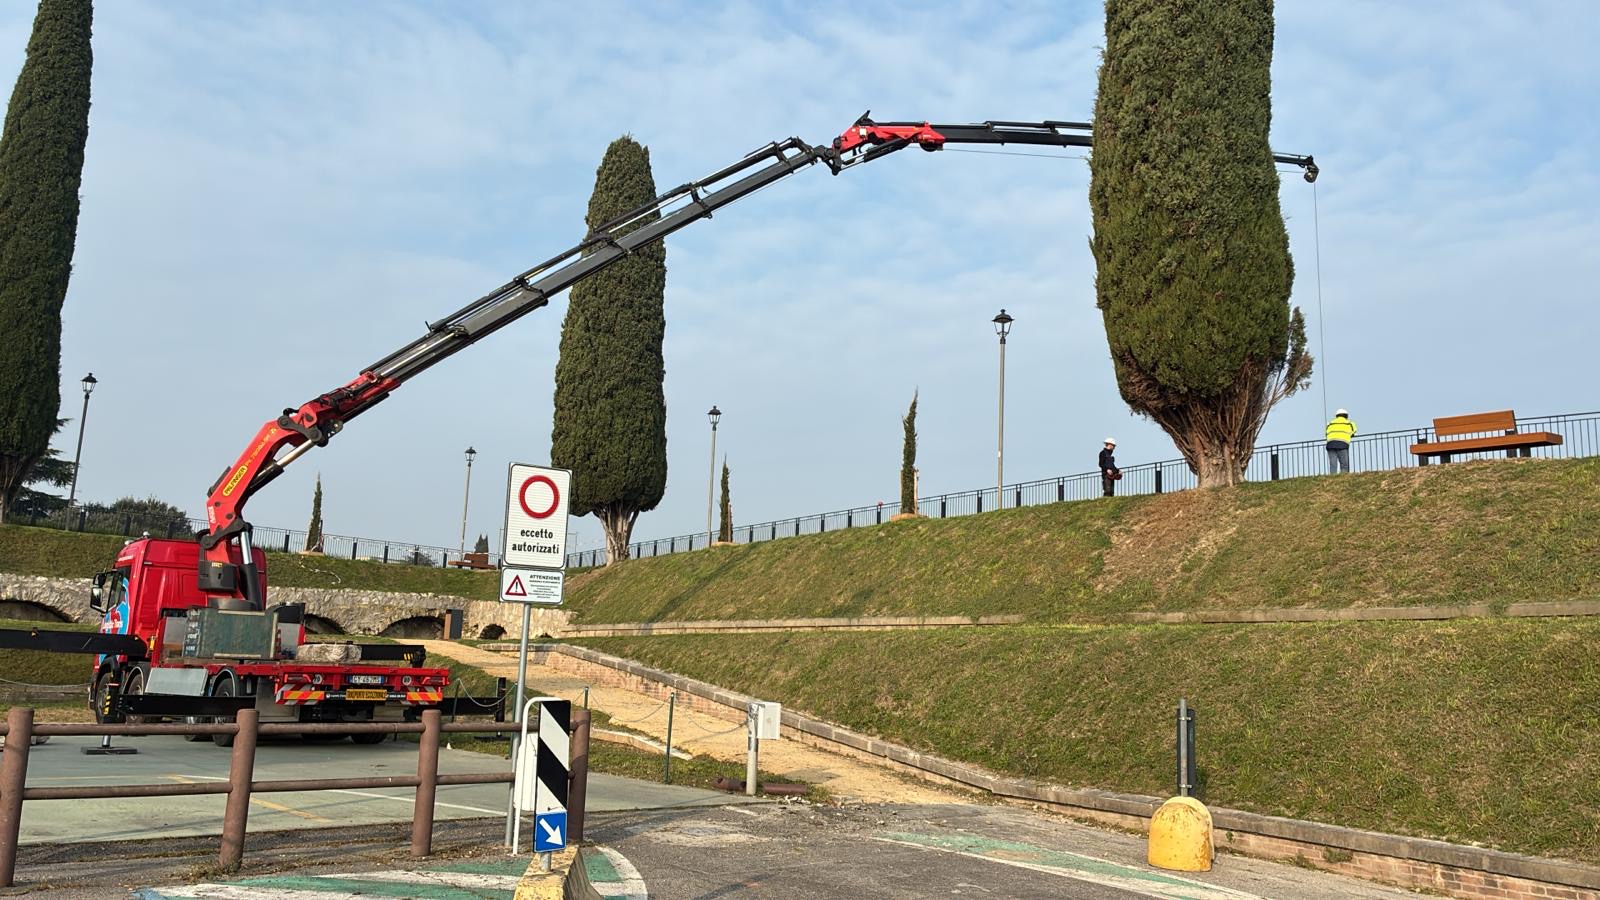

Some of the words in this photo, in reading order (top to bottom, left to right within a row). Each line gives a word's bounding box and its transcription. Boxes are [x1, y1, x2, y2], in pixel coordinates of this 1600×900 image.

[223, 467, 247, 494] PALFINGER
[520, 528, 553, 539] eccetto
[511, 542, 560, 554] autorizzati
